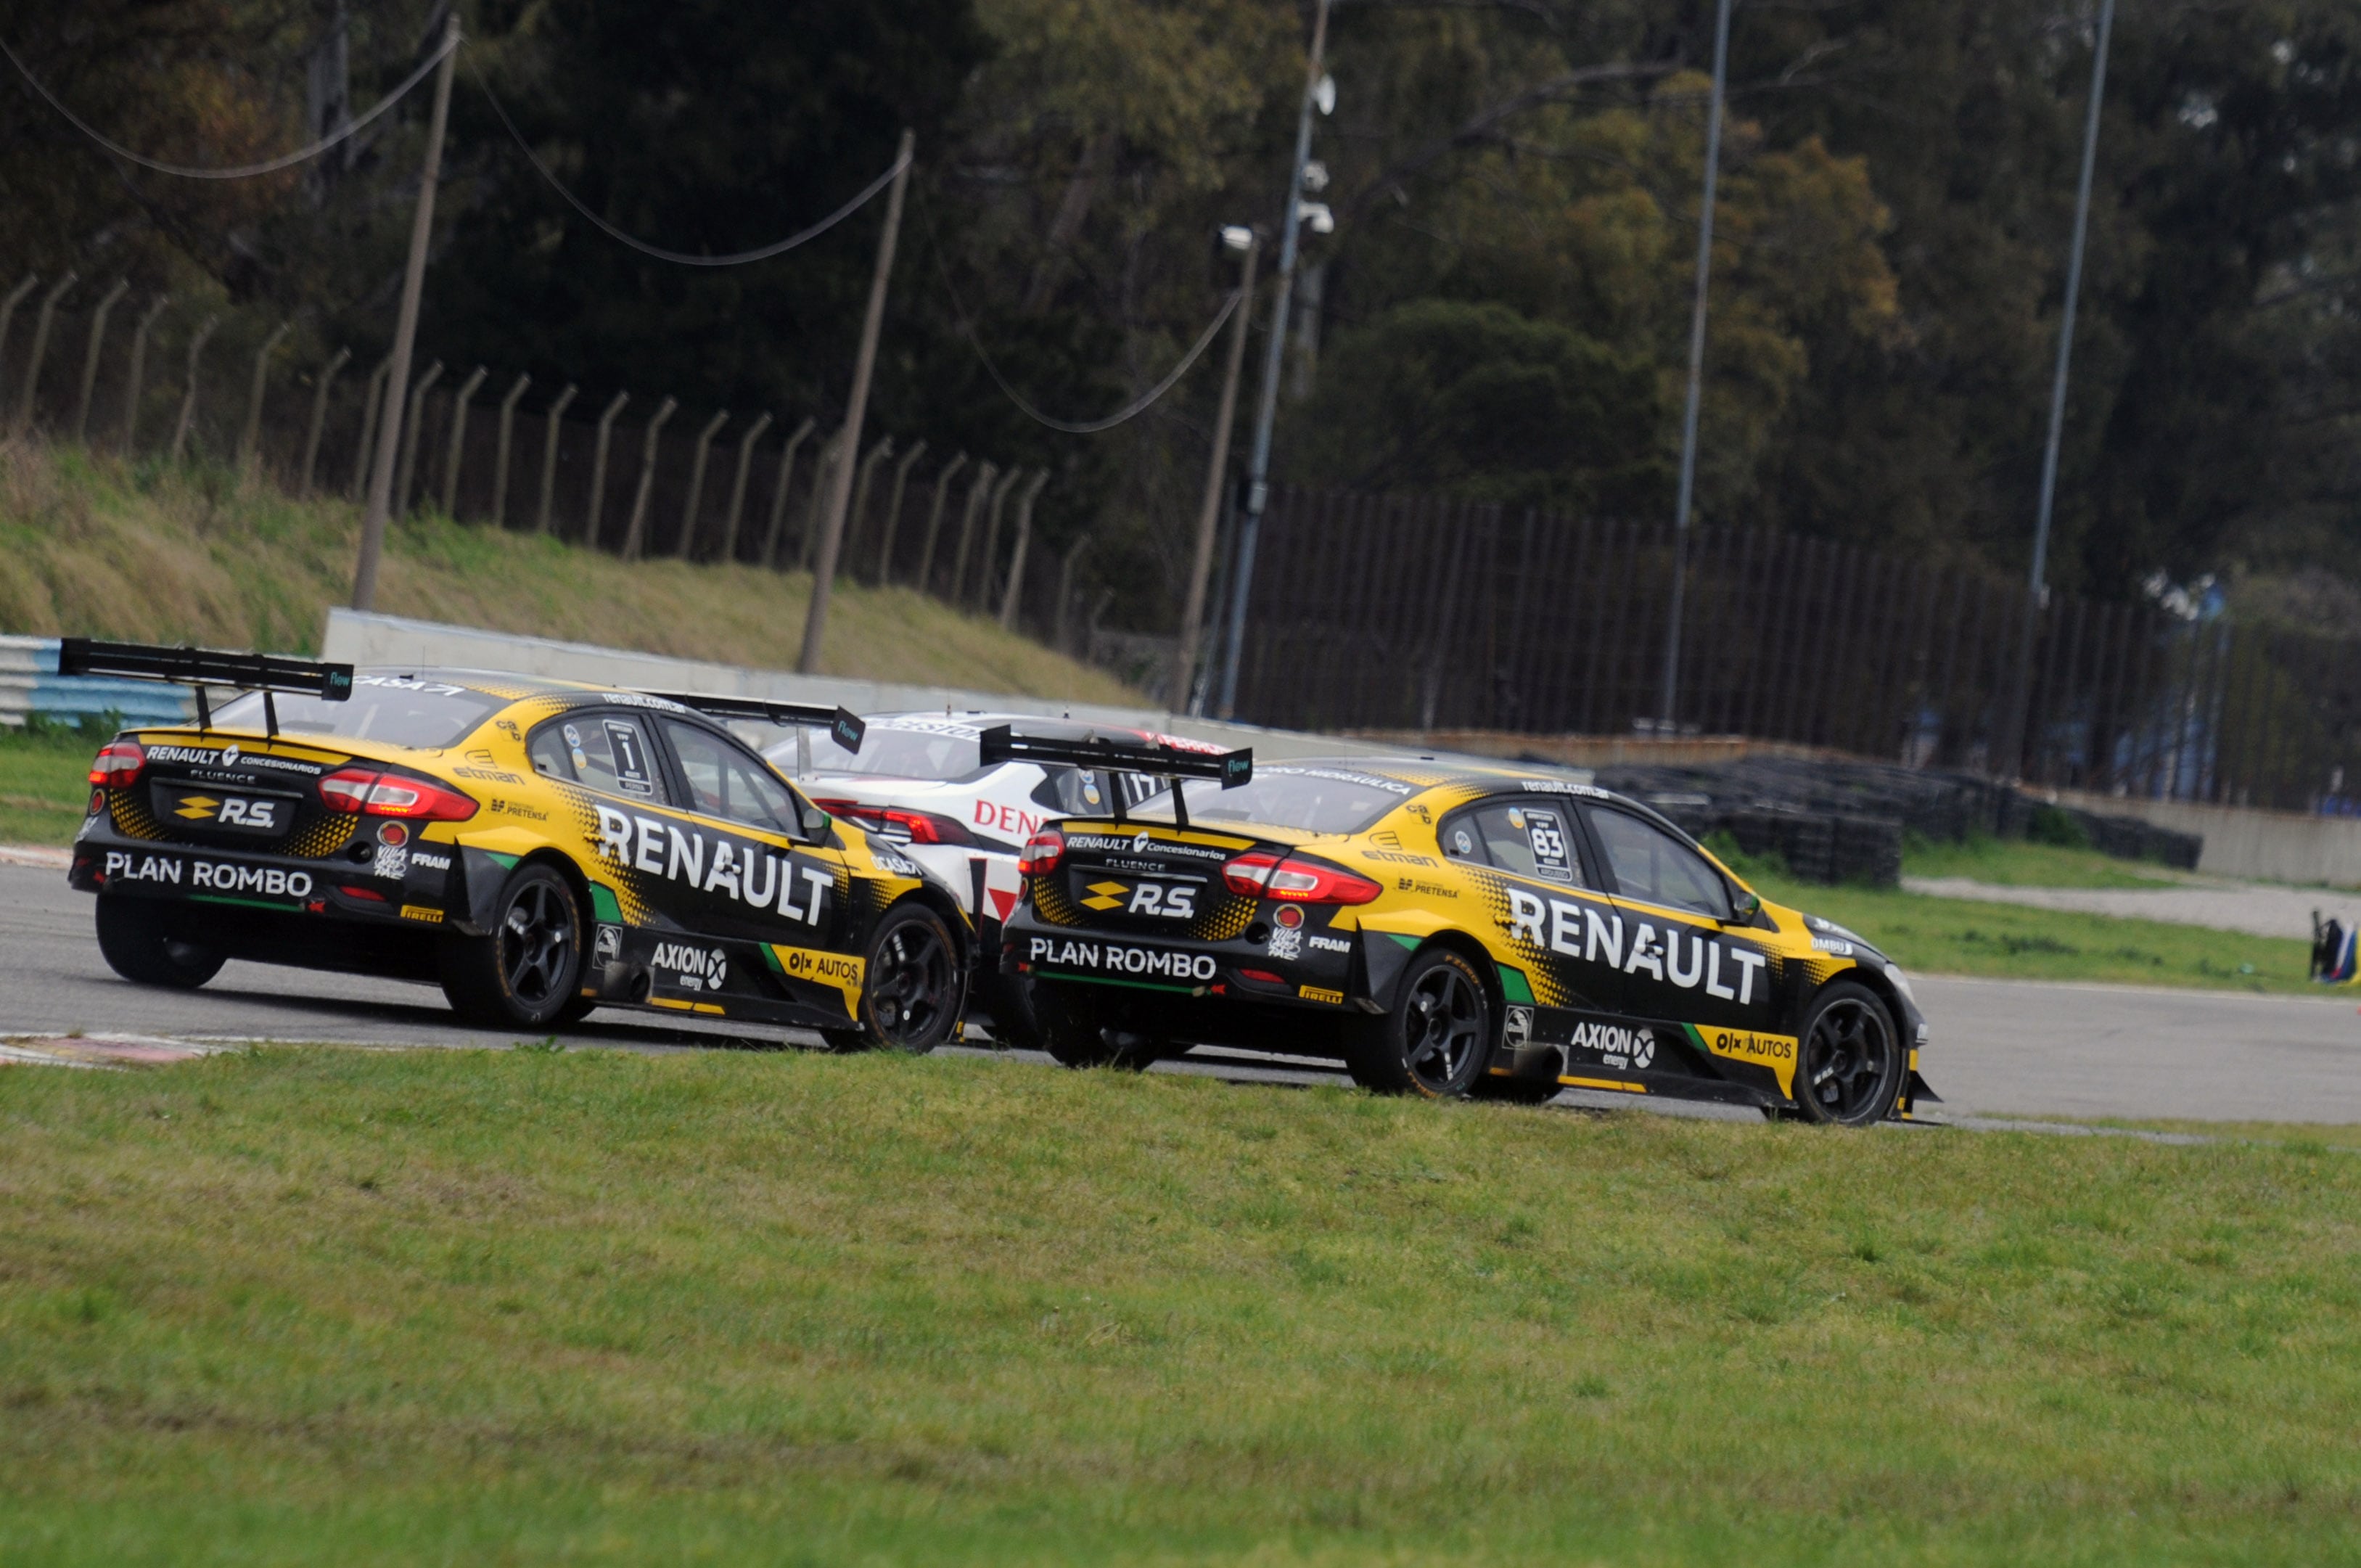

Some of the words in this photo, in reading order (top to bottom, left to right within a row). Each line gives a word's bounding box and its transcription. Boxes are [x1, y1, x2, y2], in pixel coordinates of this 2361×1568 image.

[330, 671, 350, 686] flow
[353, 675, 426, 690] CASA
[601, 693, 686, 714] renault.com.ar
[837, 720, 858, 742] flow
[146, 746, 221, 765] RENAULT
[240, 756, 321, 775] CONCESIONARIOS
[622, 742, 635, 771] 1
[1228, 759, 1249, 773] flow
[190, 769, 256, 784] FLUENCE
[1522, 780, 1609, 800] renault.com.ar
[506, 807, 547, 821] PRETENSA
[974, 800, 1048, 835] DEN
[1067, 836, 1131, 852] RENAULT
[1147, 842, 1227, 861] Concesionarios
[1531, 828, 1564, 858] 83
[411, 853, 451, 871] FRAM
[594, 804, 834, 927] RENAULT
[1106, 858, 1166, 872] FLUENCE
[105, 851, 181, 884] PLAN
[193, 861, 312, 897] ROMBO
[1415, 884, 1458, 899] PRETENSA
[400, 904, 445, 924] PIRELLI
[1308, 935, 1352, 953] FRAM
[1507, 887, 1766, 1006] RENAULT
[651, 943, 707, 975] AXION
[816, 957, 858, 981] AUTOS
[1030, 937, 1099, 968] PLAN
[1106, 945, 1217, 980] ROMBO
[679, 974, 703, 992] energy
[1299, 984, 1344, 1005] PIRELLI
[1570, 1022, 1632, 1054] AXION
[1747, 1035, 1792, 1059] AUTOS
[1603, 1054, 1629, 1070] energy
